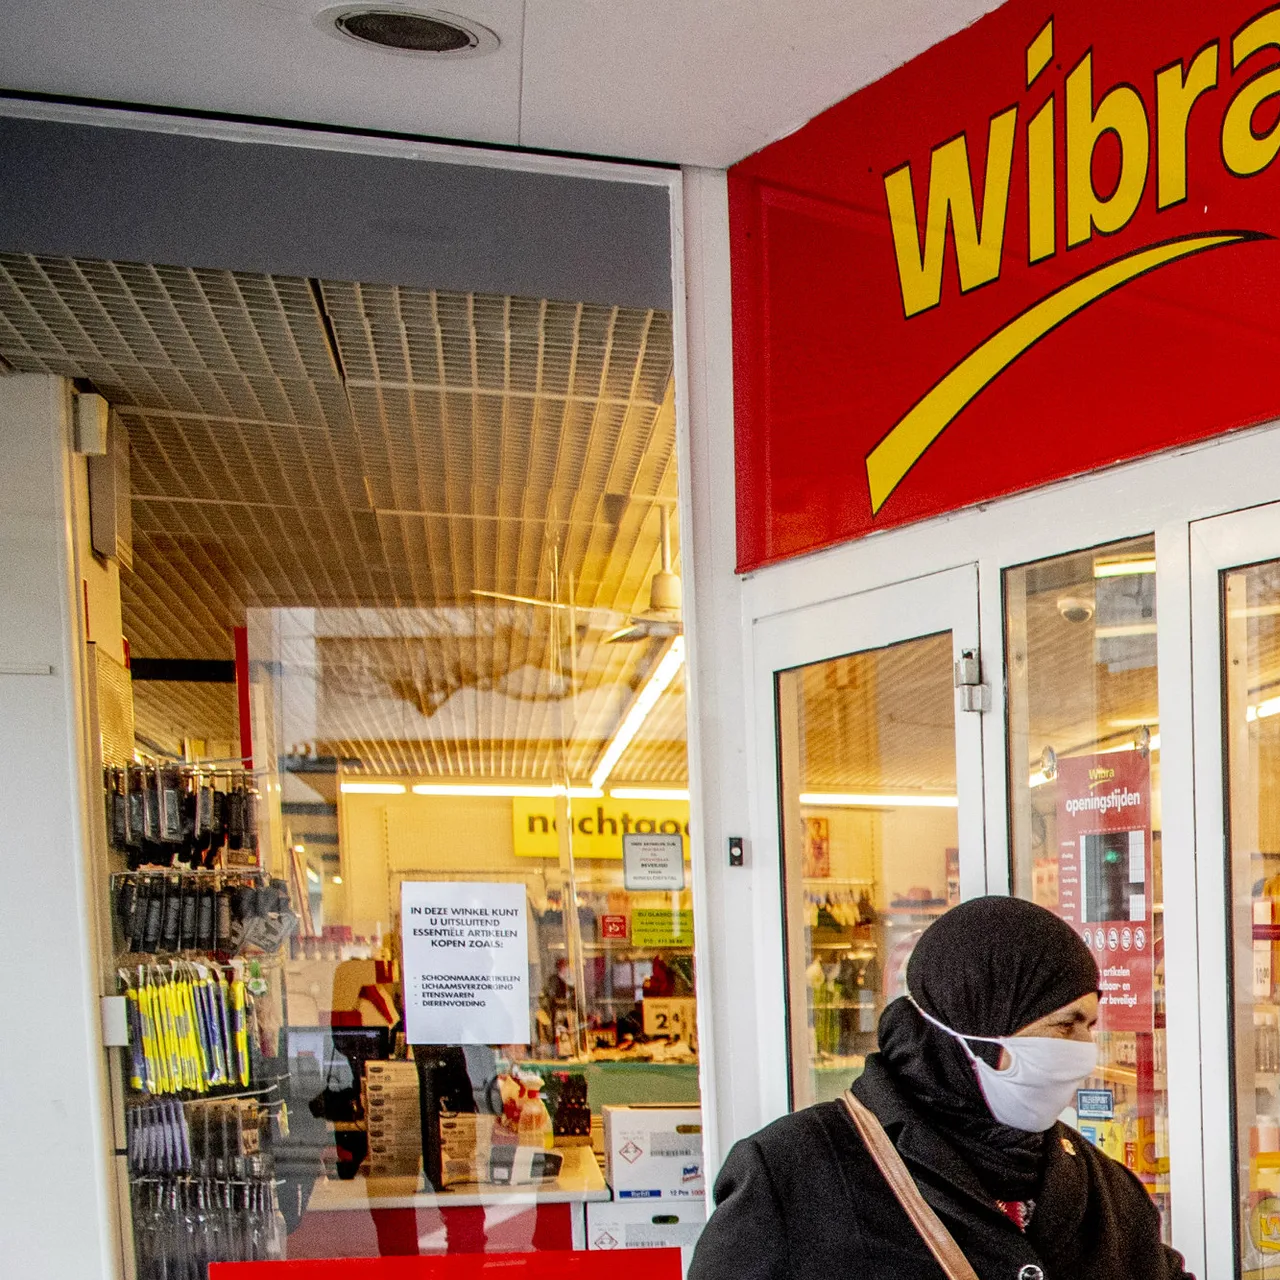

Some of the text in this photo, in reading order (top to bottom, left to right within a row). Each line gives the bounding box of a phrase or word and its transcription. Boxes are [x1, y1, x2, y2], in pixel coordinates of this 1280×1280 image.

[1066, 787, 1140, 817] openingstijden
[424, 907, 448, 915] DEZE
[451, 908, 489, 916] WINKEL
[430, 918, 500, 926] U UITSLUITEND
[413, 927, 518, 937] ESSENTIËLE ARTIKELEN
[431, 940, 466, 948] KOPEN
